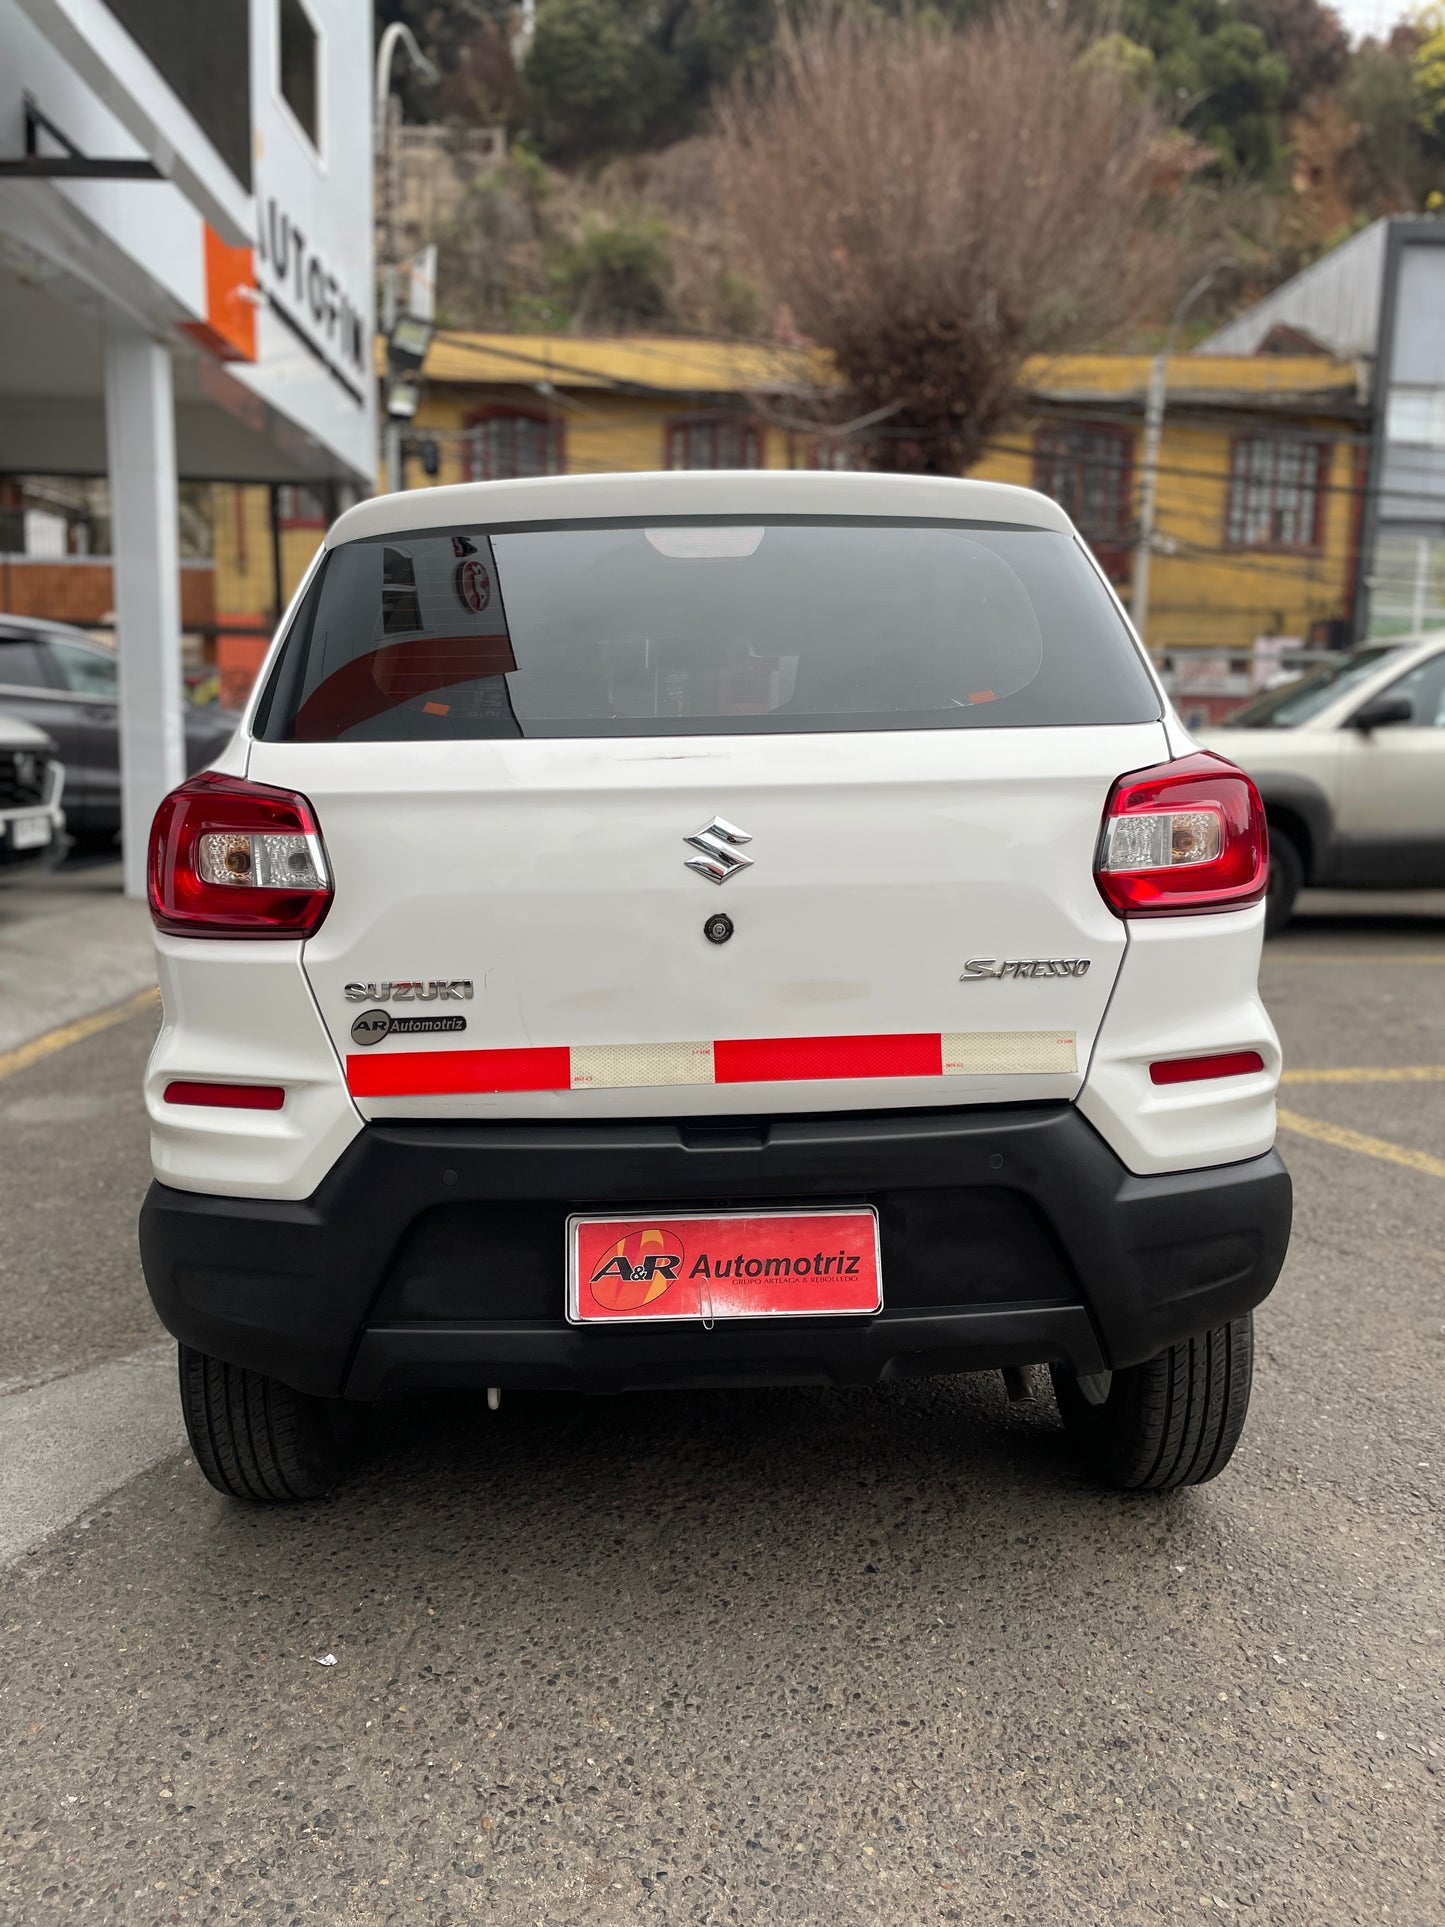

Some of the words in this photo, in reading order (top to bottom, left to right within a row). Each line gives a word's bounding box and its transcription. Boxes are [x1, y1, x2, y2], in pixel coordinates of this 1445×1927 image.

[344, 979, 474, 1003] SUZUKI
[353, 1020, 387, 1032] AR
[390, 1018, 463, 1032] Automotriz
[589, 1254, 681, 1283] A&R
[689, 1250, 861, 1280] Automotriz
[732, 1278, 762, 1286] GRUPO
[810, 1275, 859, 1283] REBOLLEDO
